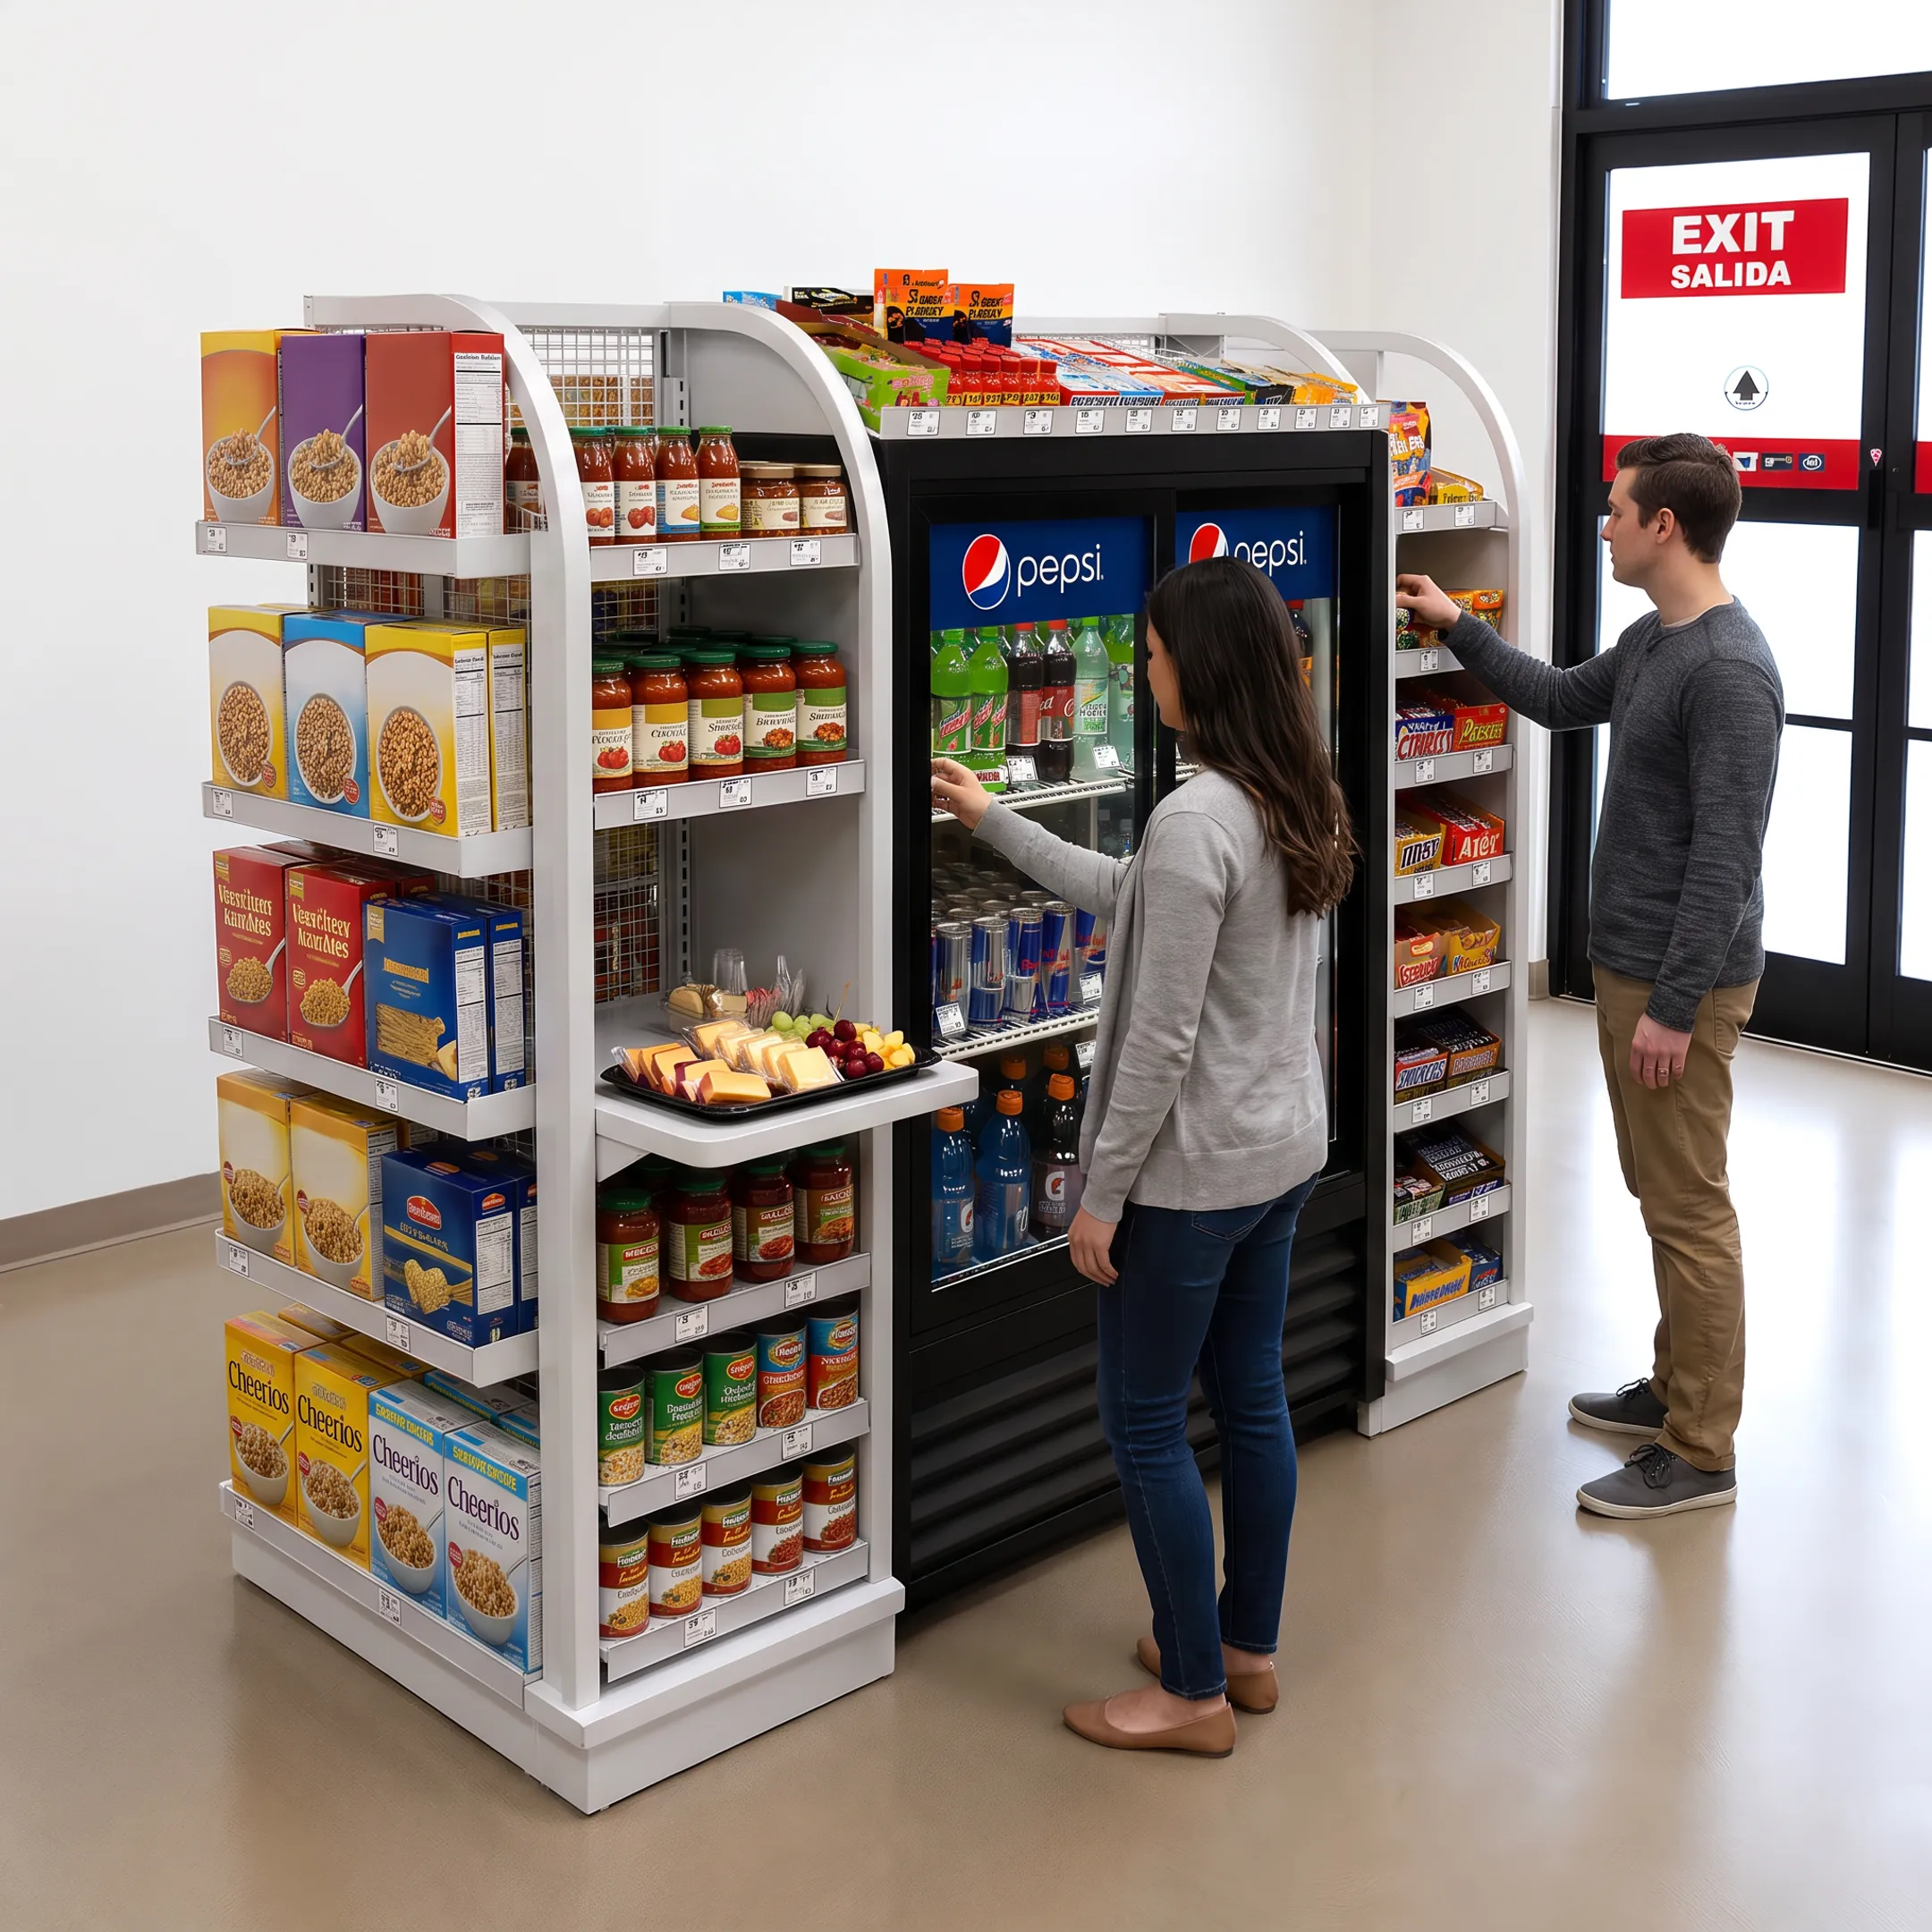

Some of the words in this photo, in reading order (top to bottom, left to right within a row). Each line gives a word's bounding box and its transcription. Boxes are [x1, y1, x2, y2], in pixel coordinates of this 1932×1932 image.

[1672, 210, 1794, 255] EXIT
[1671, 260, 1792, 289] SALIDA
[1017, 544, 1100, 597] pepsi
[228, 1360, 289, 1414] Cheerios
[298, 1394, 362, 1453] Cheerios
[373, 1434, 438, 1496] Cheerios
[447, 1476, 519, 1541] Cheerios
